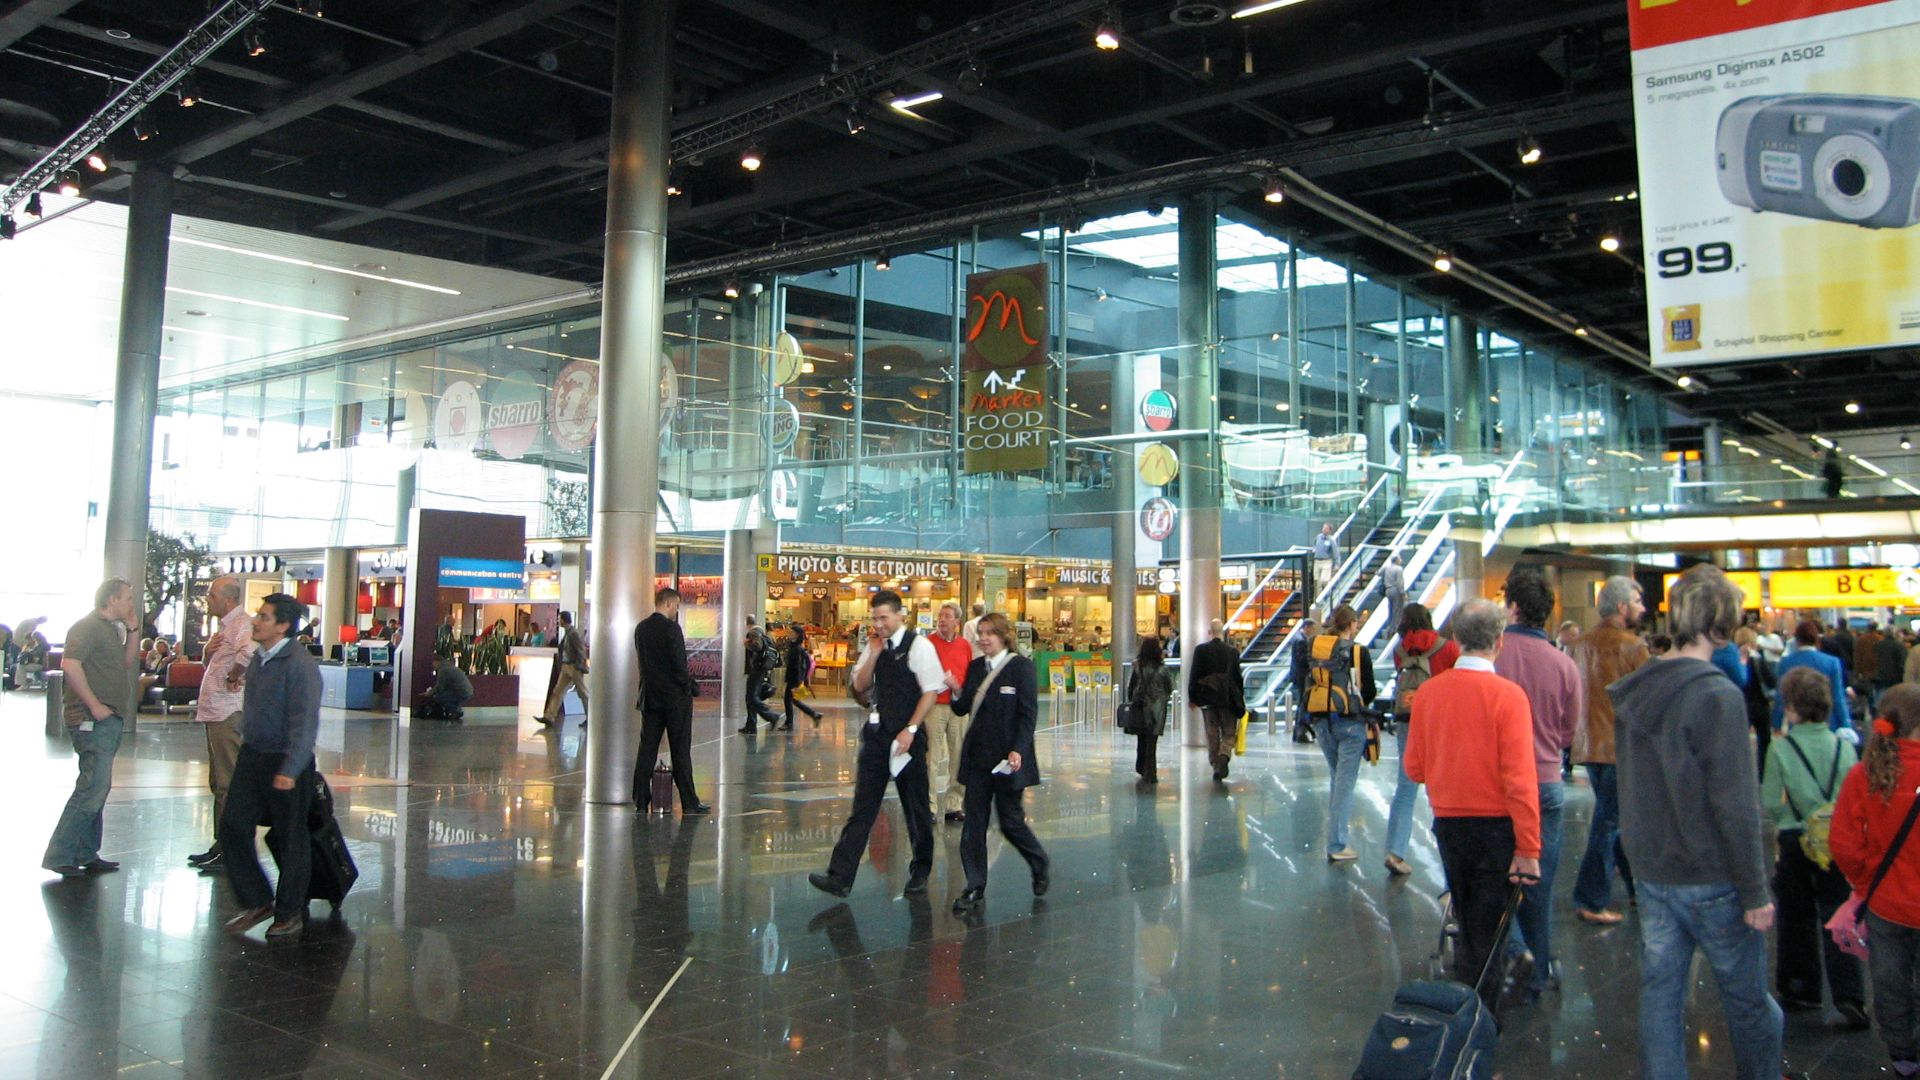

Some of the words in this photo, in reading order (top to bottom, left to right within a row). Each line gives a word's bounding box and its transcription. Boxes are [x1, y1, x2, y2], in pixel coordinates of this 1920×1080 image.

[1646, 68, 1712, 88] Samsung
[1717, 57, 1775, 76] Digimax
[1780, 45, 1825, 64] A502
[1714, 337, 1755, 348] Schiphol
[1758, 332, 1805, 344] Shopping
[970, 390, 1043, 412] Market
[490, 400, 540, 426] sbarro
[1145, 405, 1172, 417] sbarro
[773, 418, 793, 436] ING
[966, 411, 1044, 431] FOOD
[966, 430, 1043, 450] COURT
[778, 555, 831, 572] PHOTO
[835, 555, 848, 574] &
[851, 558, 949, 577] ELECTRONICS
[1060, 569, 1099, 584] MUSIC
[1101, 568, 1111, 584] &
[1137, 573, 1156, 586] IES
[1837, 575, 1851, 594] B
[1859, 575, 1875, 594] C
[769, 585, 784, 595] DVD
[812, 587, 827, 596] DVD
